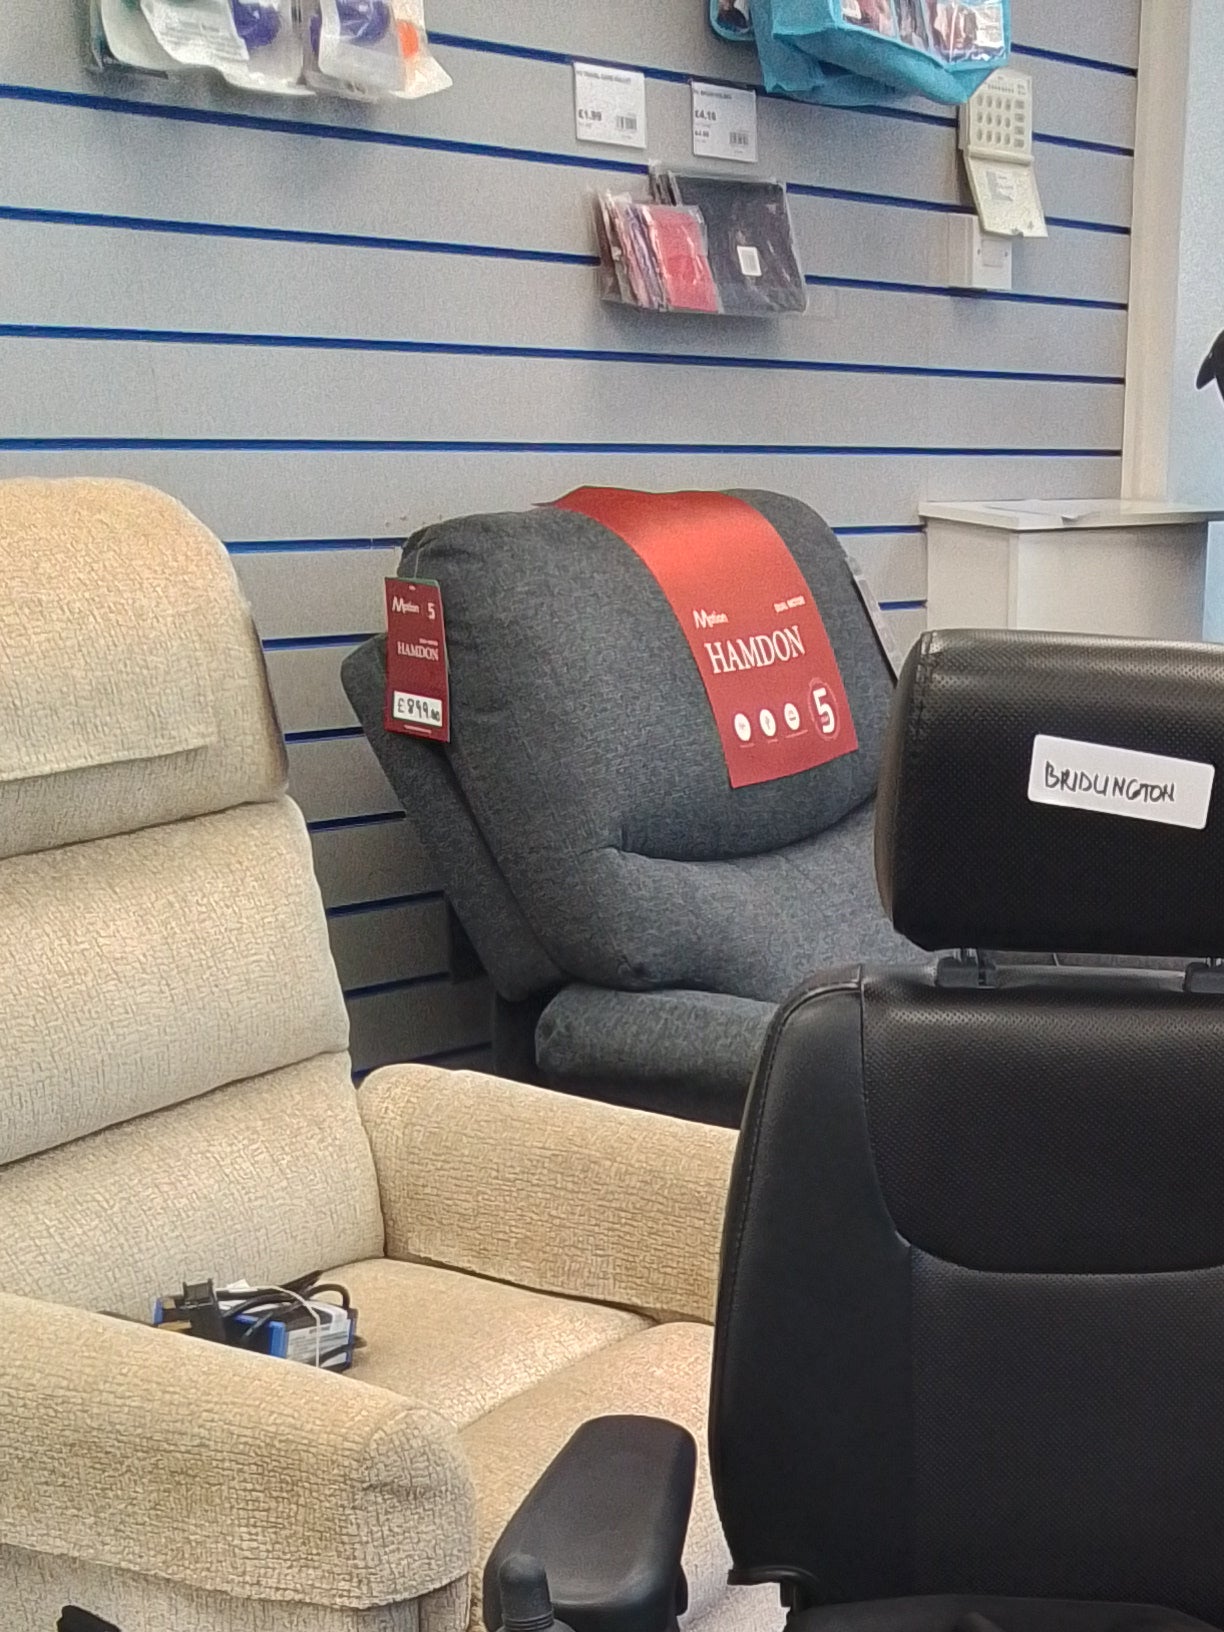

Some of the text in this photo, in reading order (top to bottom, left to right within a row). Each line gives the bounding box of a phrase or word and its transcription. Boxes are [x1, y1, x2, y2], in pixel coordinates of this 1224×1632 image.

[427, 602, 436, 620] 5
[691, 609, 729, 629] Motion
[397, 641, 439, 661] HAMDON
[703, 624, 806, 674] HAMDON
[812, 687, 835, 734] 5
